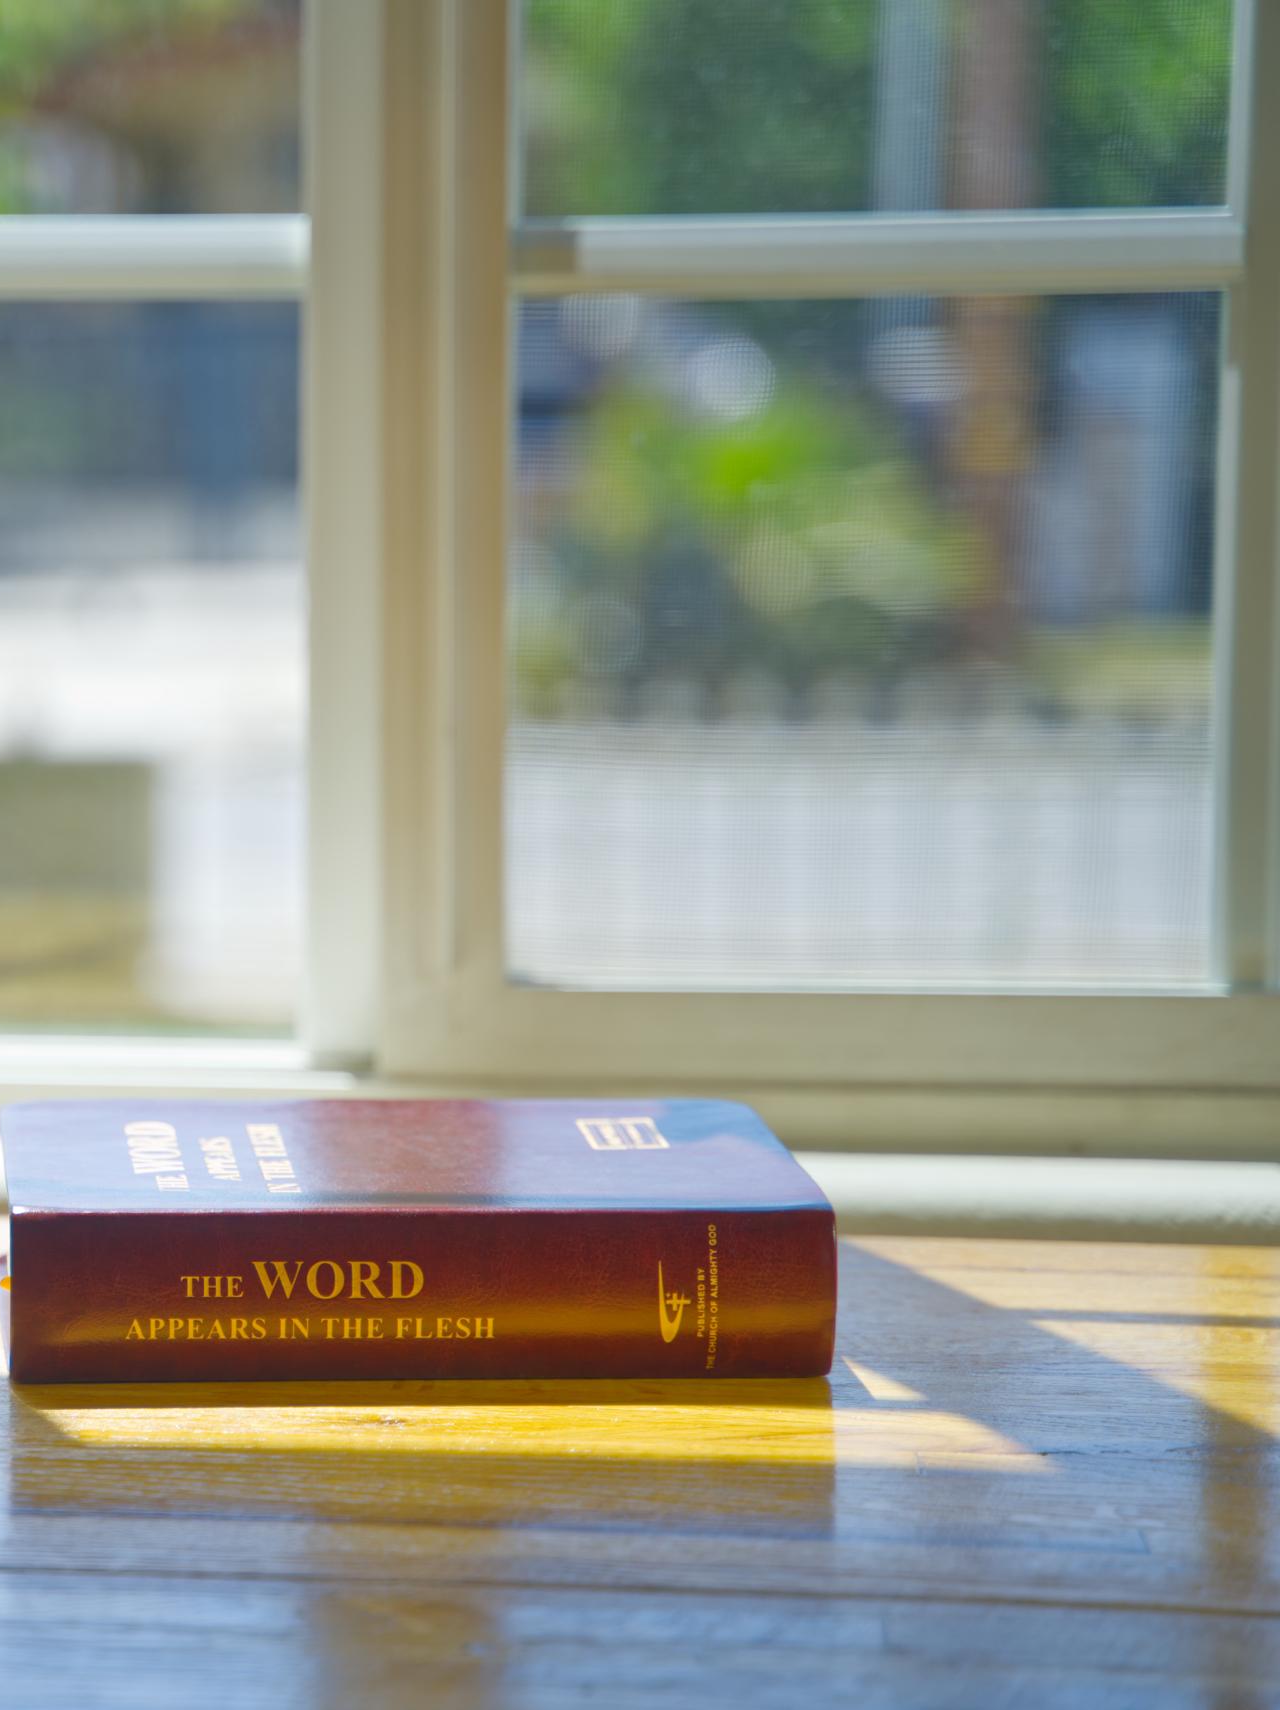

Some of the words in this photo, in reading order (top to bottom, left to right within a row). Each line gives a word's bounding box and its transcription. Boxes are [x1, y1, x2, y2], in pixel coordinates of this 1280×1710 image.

[124, 1121, 185, 1174] WORD
[708, 1224, 717, 1246] GOD
[181, 1275, 244, 1299] THE
[251, 1260, 425, 1300] WORD
[697, 1267, 705, 1281] BY
[709, 1249, 719, 1298] ALMIGHTY
[697, 1283, 705, 1337] PUBLISHED
[710, 1299, 718, 1314] OF
[125, 1317, 266, 1340] APPEARS
[279, 1317, 310, 1340] IN
[320, 1317, 384, 1340] THE
[394, 1317, 495, 1340] FLESH
[708, 1316, 718, 1353] CHURCH
